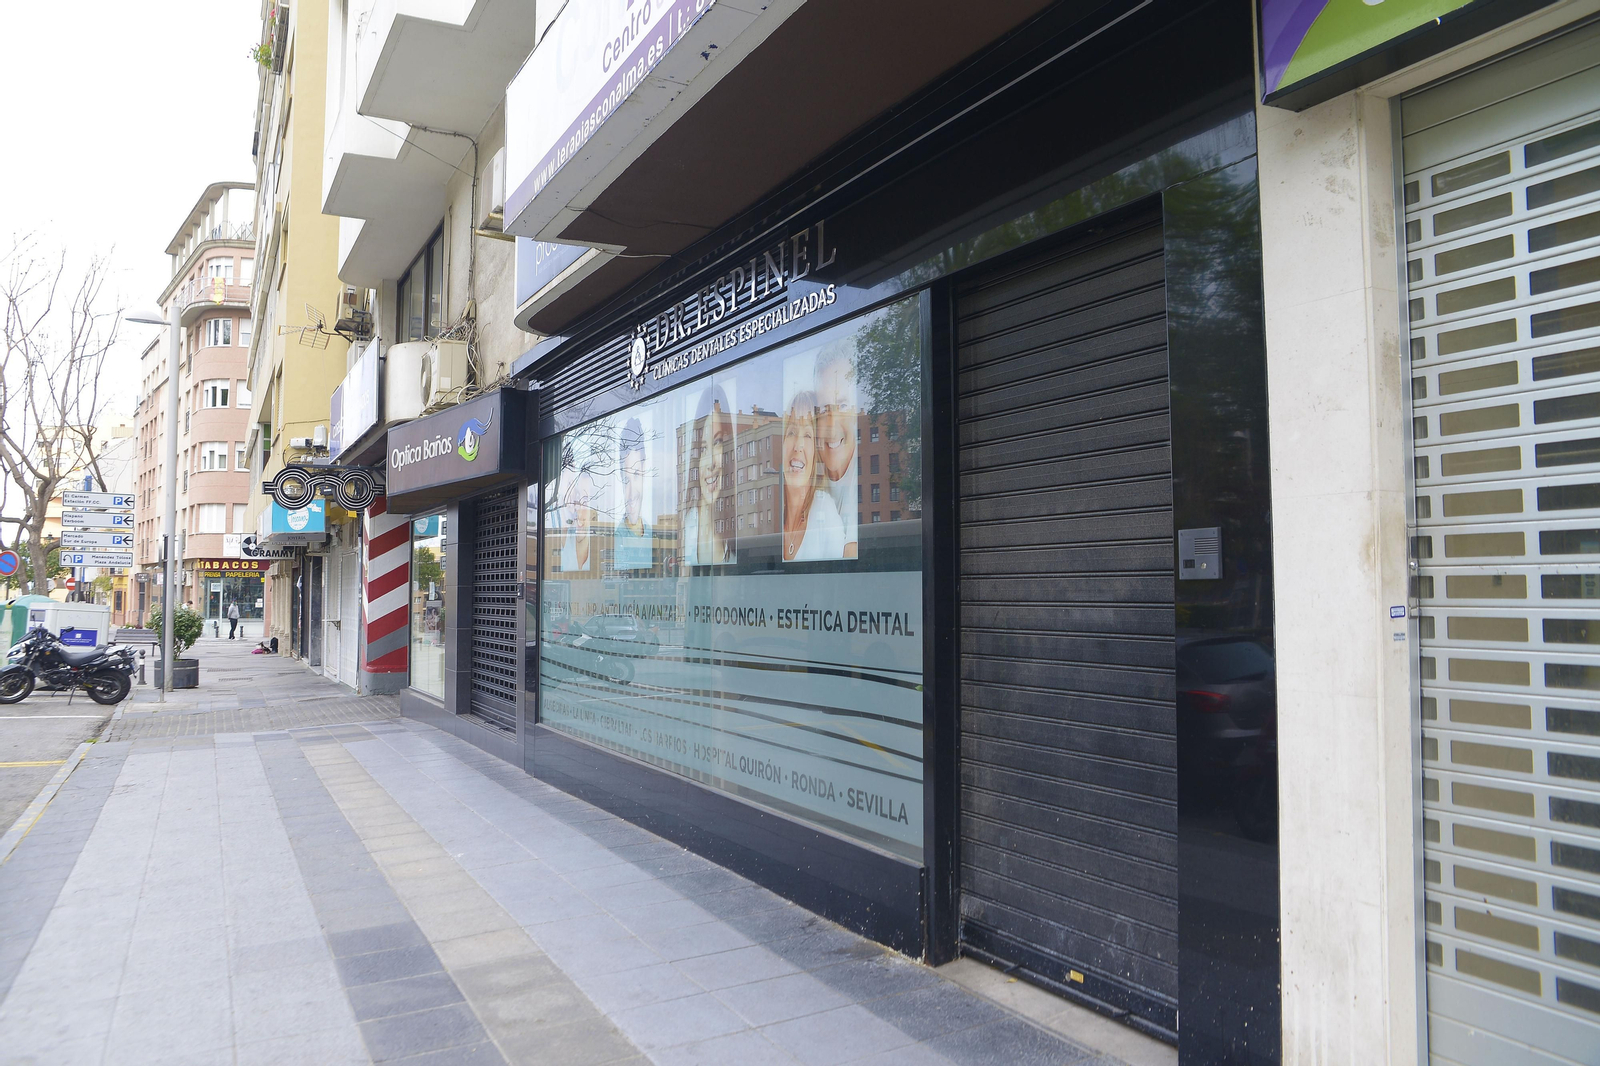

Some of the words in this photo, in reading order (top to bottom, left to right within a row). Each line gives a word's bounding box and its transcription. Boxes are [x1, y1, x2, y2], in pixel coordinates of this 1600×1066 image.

[603, 0, 651, 73] Centro
[532, 35, 664, 193] www.terapiasconalma.es
[690, 330, 738, 363] DENTALES
[739, 283, 837, 343] ESPECIALIZADAS
[391, 444, 422, 472] Optica
[423, 434, 452, 460] Baños
[200, 561, 259, 569] TABACOS
[252, 549, 295, 558] GRAMMY
[693, 605, 767, 628] PERIODONCIA
[777, 603, 843, 633] ESTÉTICA
[848, 611, 915, 637] DENTAL
[740, 756, 781, 784] QUIRÓN
[791, 770, 836, 802] RONDA
[847, 787, 909, 826] SEVILLA
